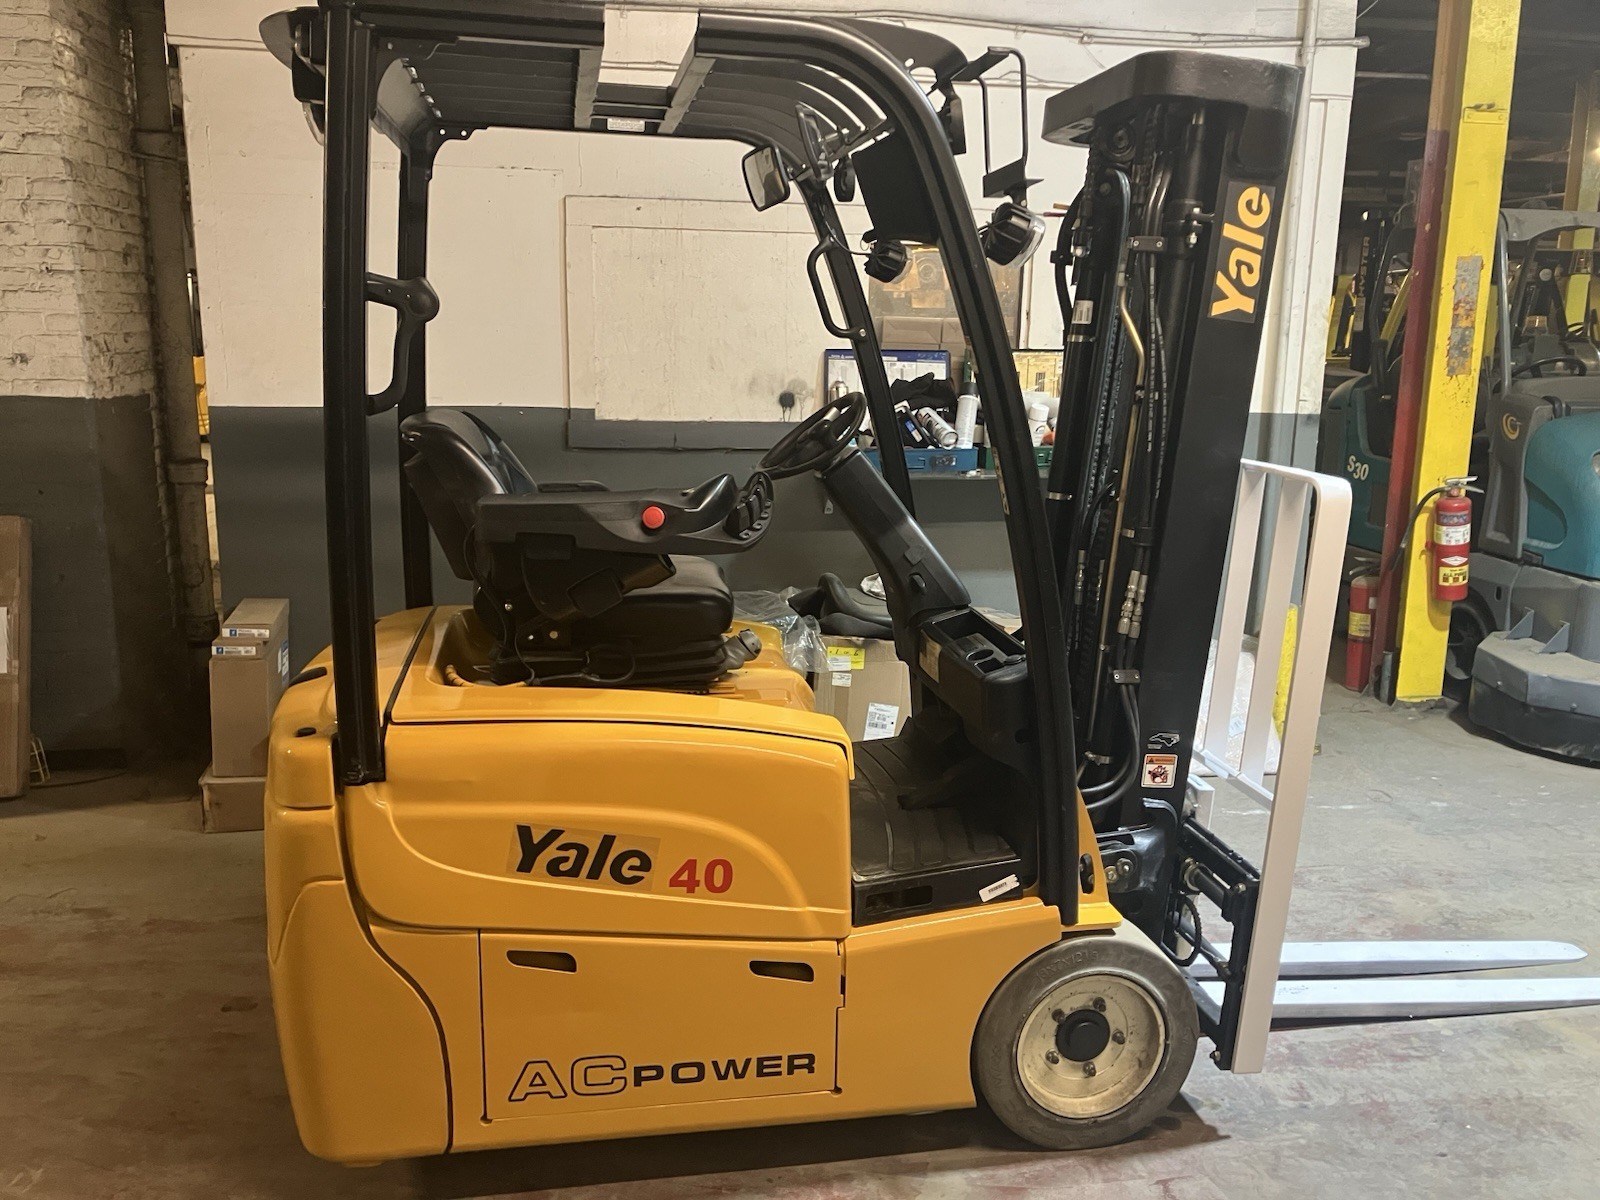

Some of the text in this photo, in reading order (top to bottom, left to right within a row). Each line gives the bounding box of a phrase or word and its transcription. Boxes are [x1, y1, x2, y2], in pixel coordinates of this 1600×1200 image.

[1211, 186, 1271, 316] Yale
[1347, 455, 1370, 481] S30
[516, 824, 733, 894] Yale 40
[507, 1052, 816, 1102] AC POWER
